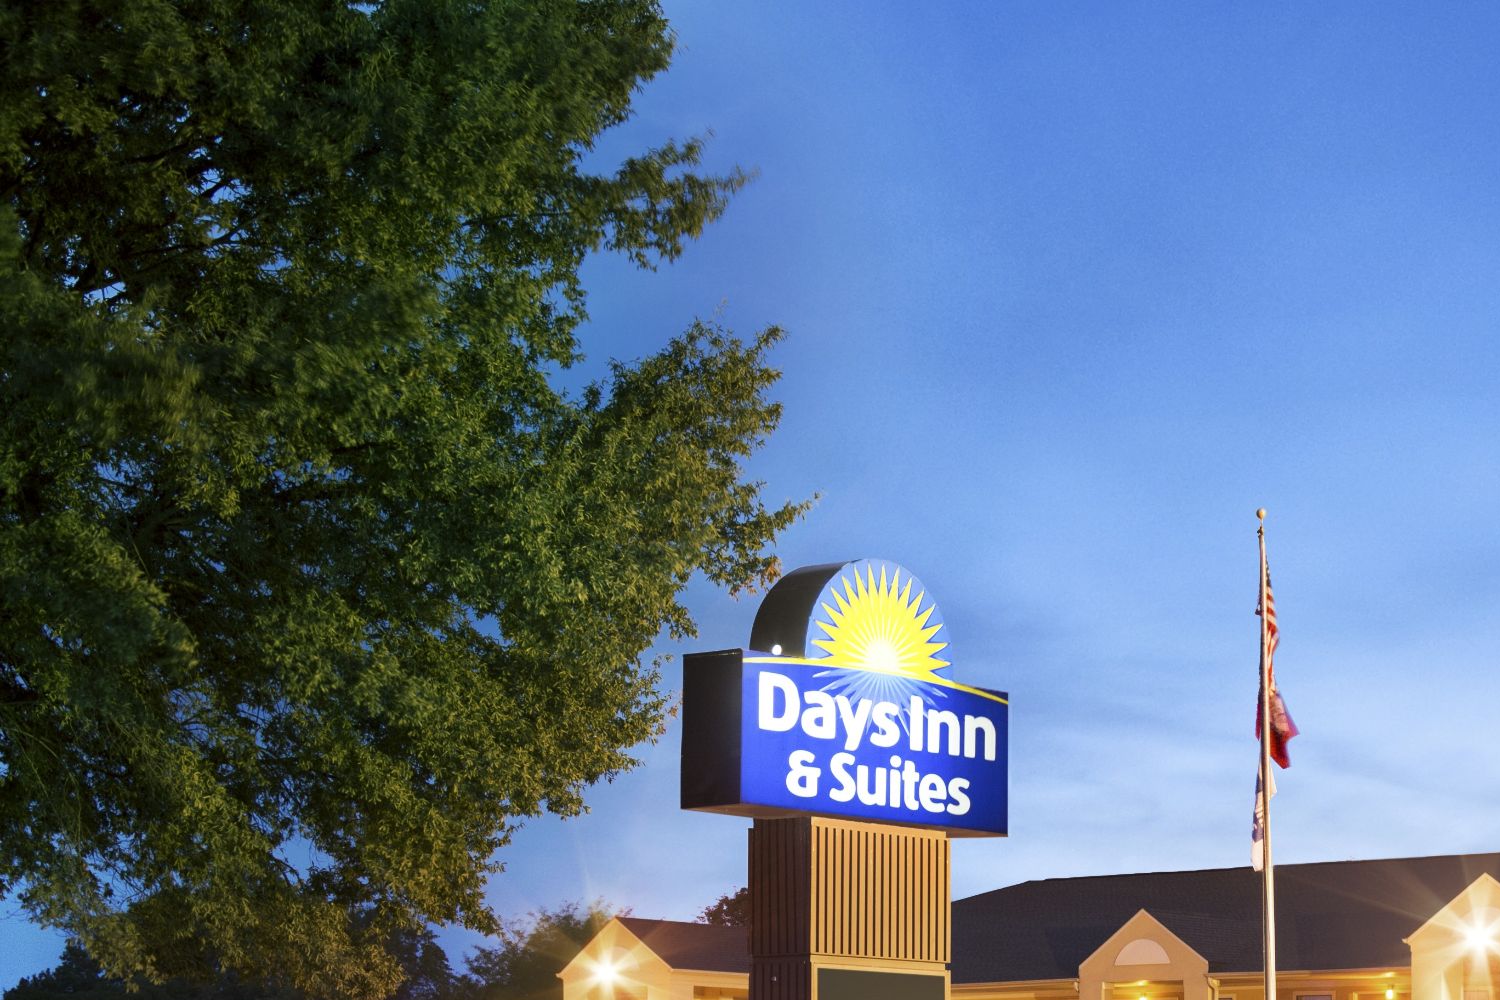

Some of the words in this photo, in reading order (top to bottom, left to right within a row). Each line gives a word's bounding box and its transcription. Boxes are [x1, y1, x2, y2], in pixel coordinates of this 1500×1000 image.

[758, 671, 900, 751] Days
[909, 695, 996, 761] Inn
[786, 750, 821, 798] &
[829, 752, 971, 815] Suites
